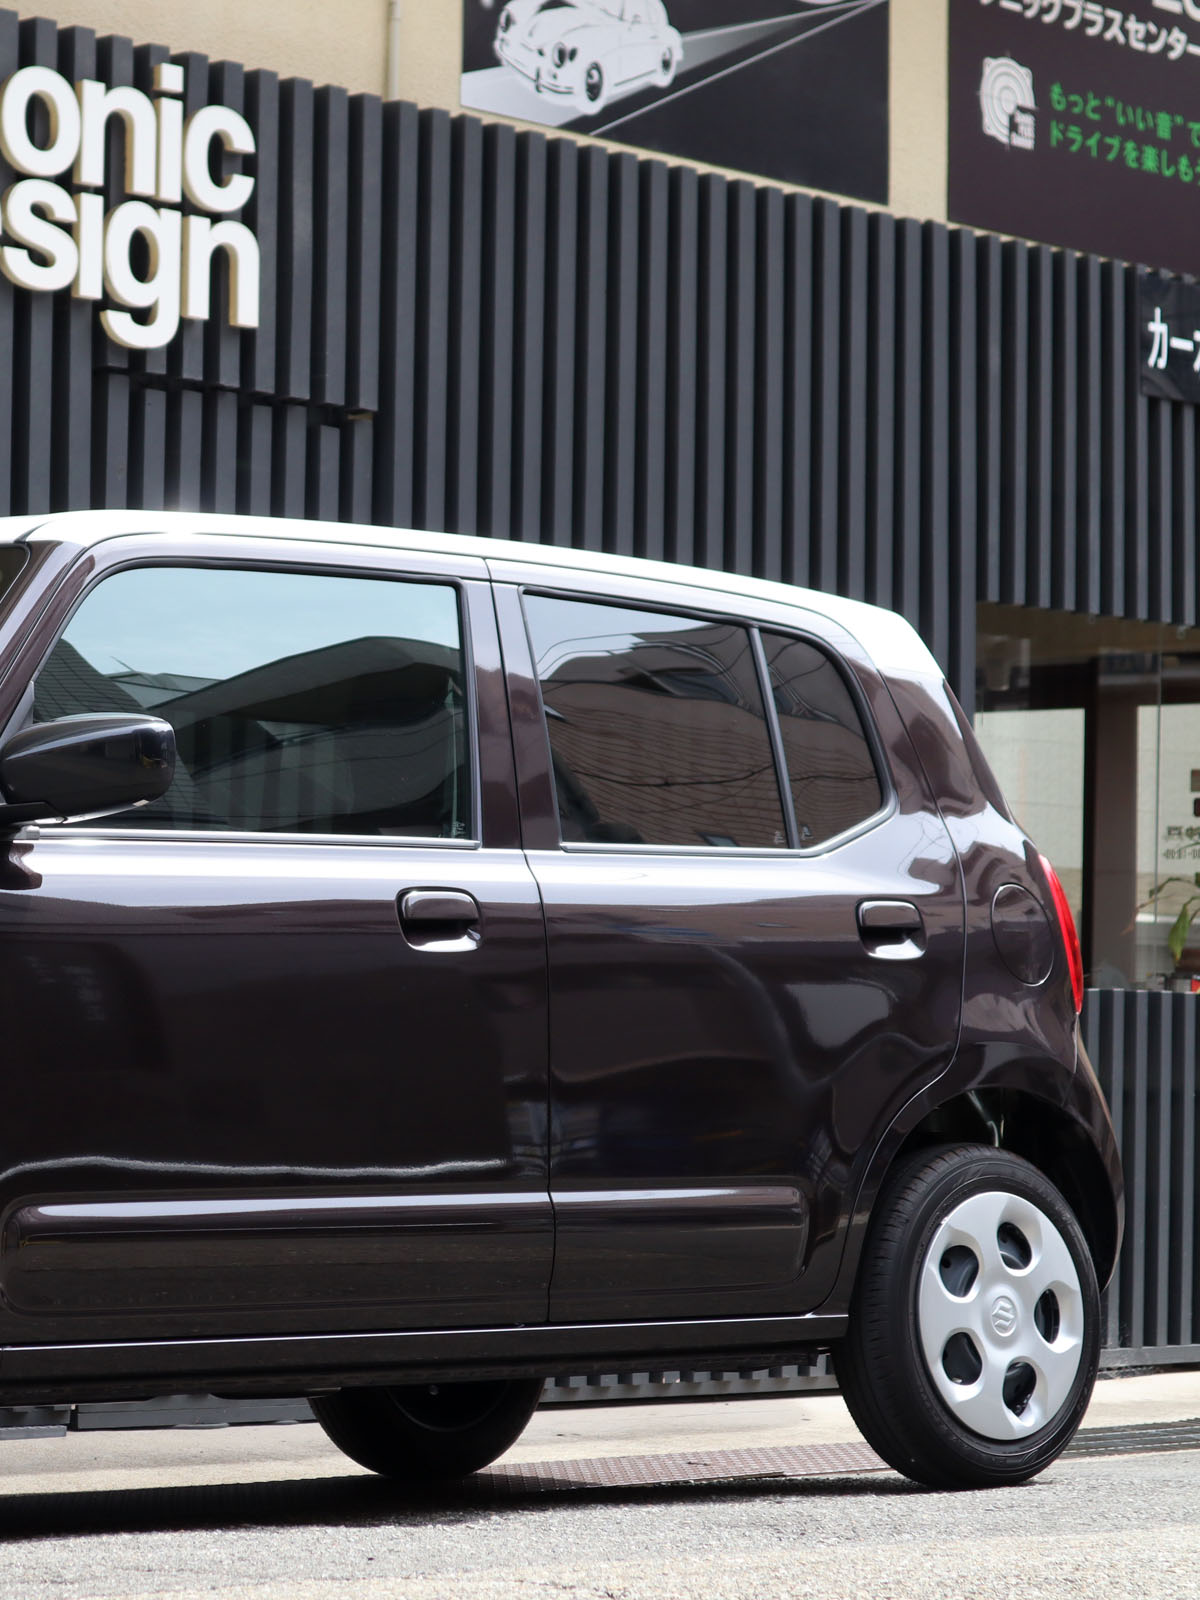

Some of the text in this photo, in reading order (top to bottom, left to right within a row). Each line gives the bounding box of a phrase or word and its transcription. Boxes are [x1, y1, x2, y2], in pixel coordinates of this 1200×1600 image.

[979, 0, 1200, 60] ックプラスセンター
[1050, 120, 1200, 187] ドライブを楽しも
